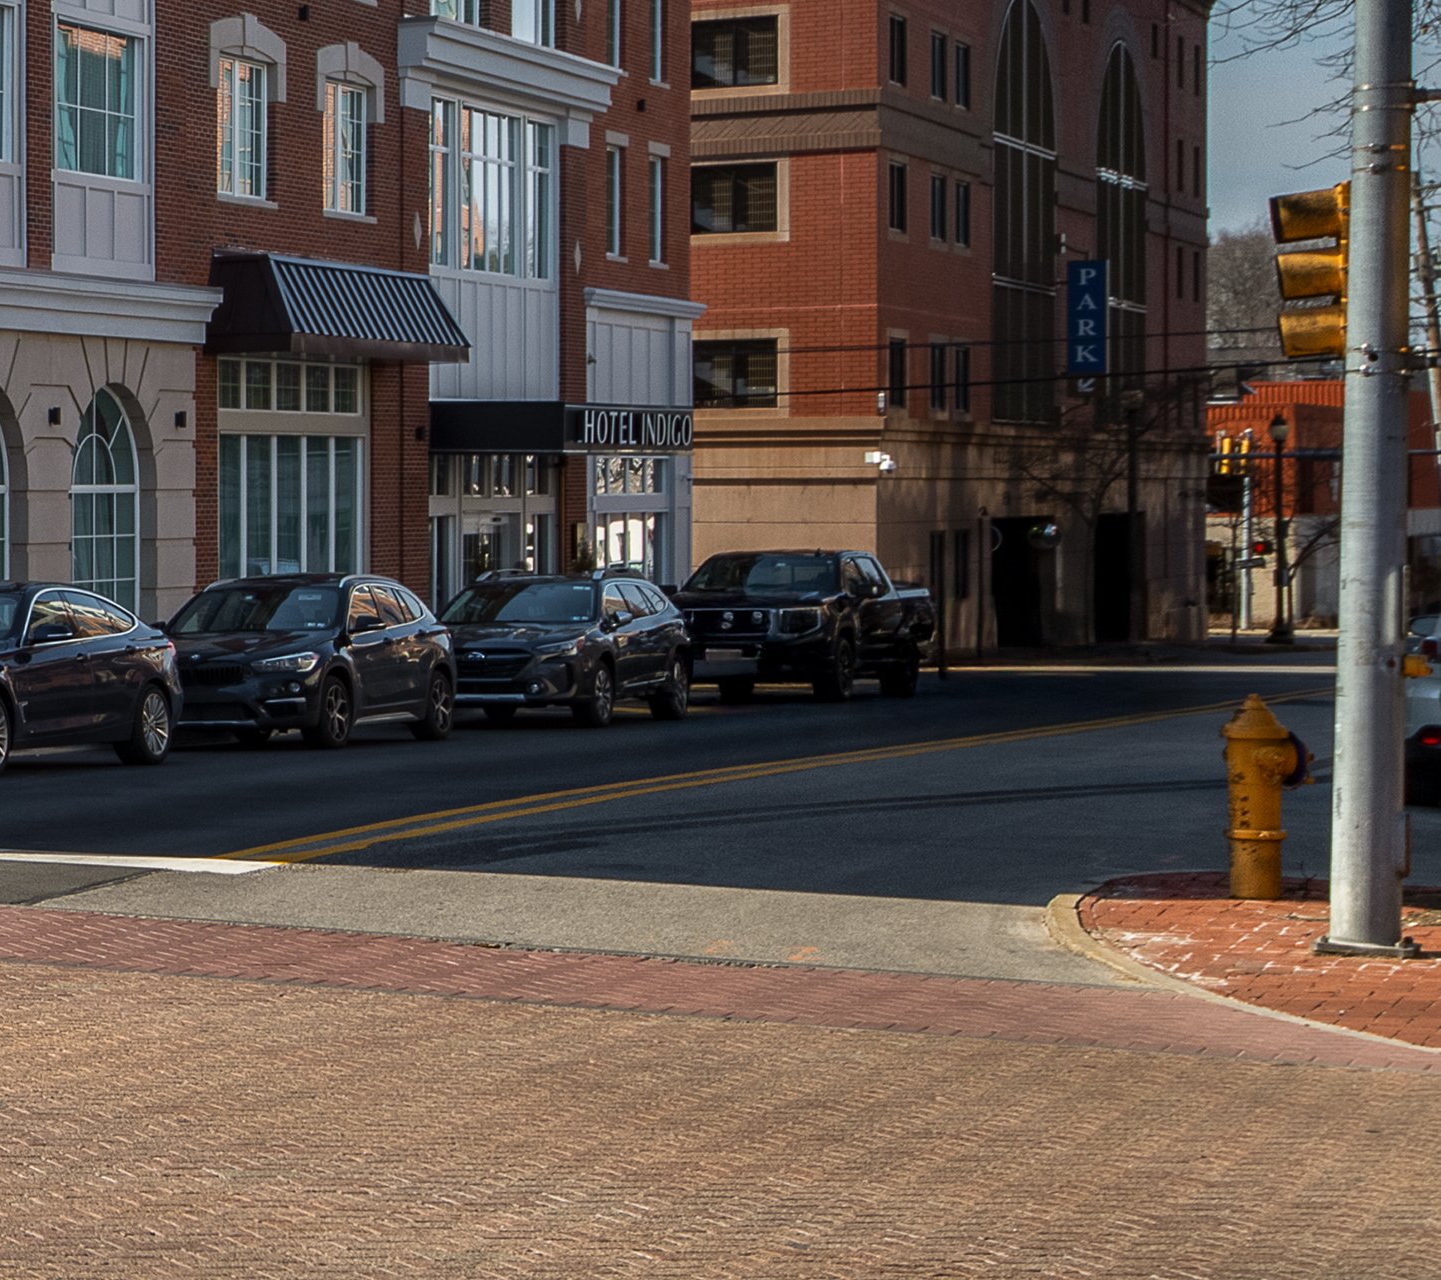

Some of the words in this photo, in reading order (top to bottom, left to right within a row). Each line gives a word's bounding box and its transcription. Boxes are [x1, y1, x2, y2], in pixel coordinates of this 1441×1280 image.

[1075, 268, 1098, 363] PARK
[584, 410, 637, 445] HOTEL
[641, 412, 692, 446] INDIGO
